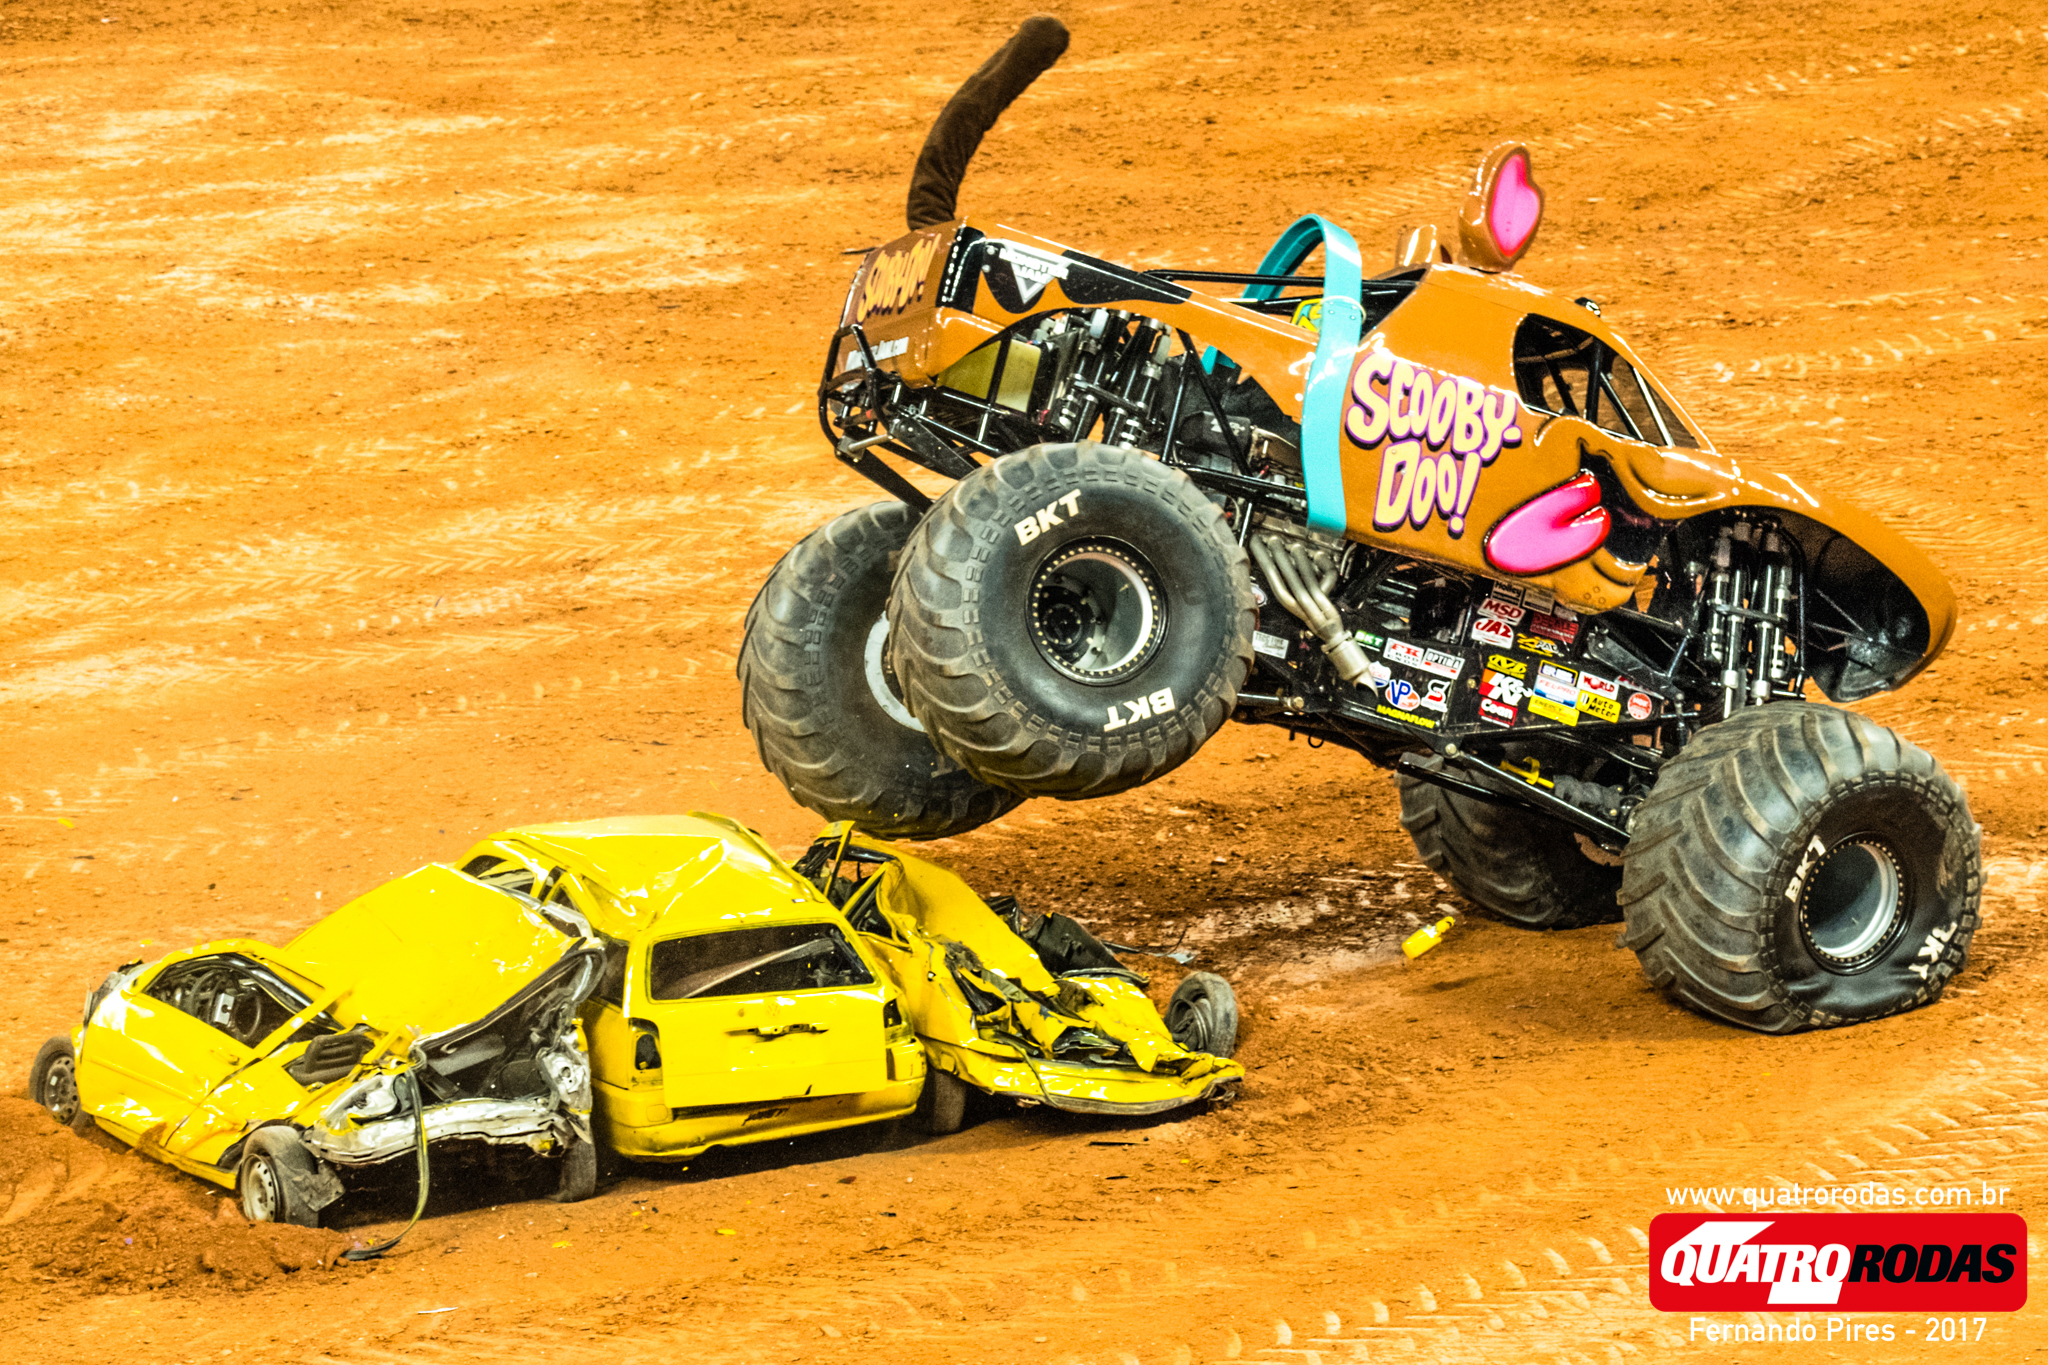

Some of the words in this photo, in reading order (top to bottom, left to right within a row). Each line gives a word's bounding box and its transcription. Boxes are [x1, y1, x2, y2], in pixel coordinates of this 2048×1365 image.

[1014, 489, 1081, 546] BKT
[1484, 600, 1522, 618] MSD
[1354, 632, 1384, 647] BKT
[1426, 651, 1460, 669] OPTIMA
[1391, 681, 1411, 705] VP
[1583, 675, 1615, 693] WORLD
[1103, 687, 1175, 732] BKT
[1481, 698, 1514, 719] Coan
[1588, 705, 1616, 718] Meter
[1592, 697, 1614, 710] Auto
[1376, 704, 1435, 729] MAGNAFLOW
[1785, 834, 1827, 902] BKT
